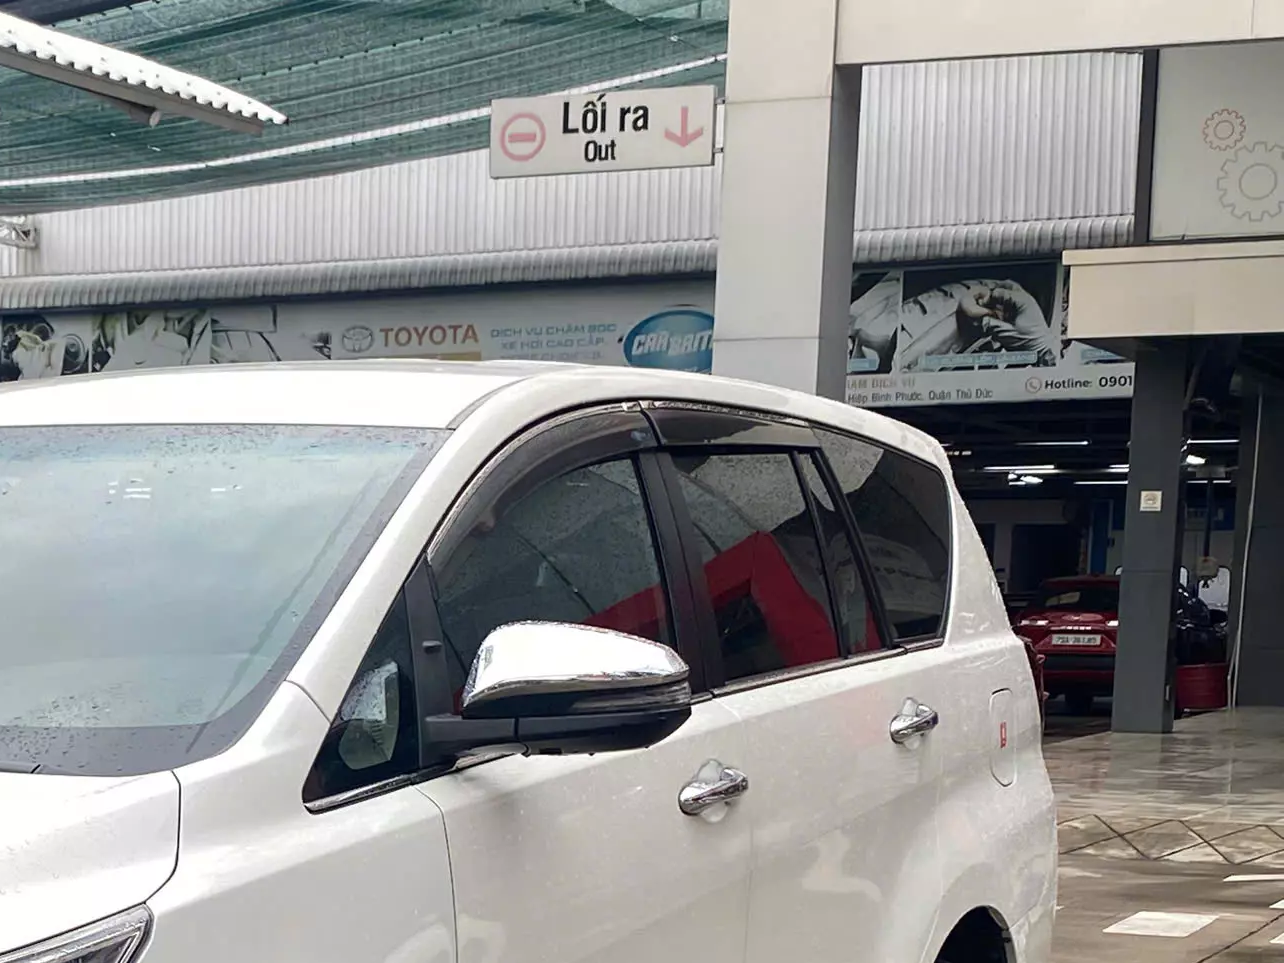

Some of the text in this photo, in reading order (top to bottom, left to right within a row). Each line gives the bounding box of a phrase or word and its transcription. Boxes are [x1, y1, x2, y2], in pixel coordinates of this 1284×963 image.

[562, 93, 649, 134] Lối ra
[584, 139, 616, 162] Out
[379, 324, 479, 347] TOYOTA
[547, 338, 574, 348] CAO
[1044, 375, 1133, 389] Hotline: 0901
